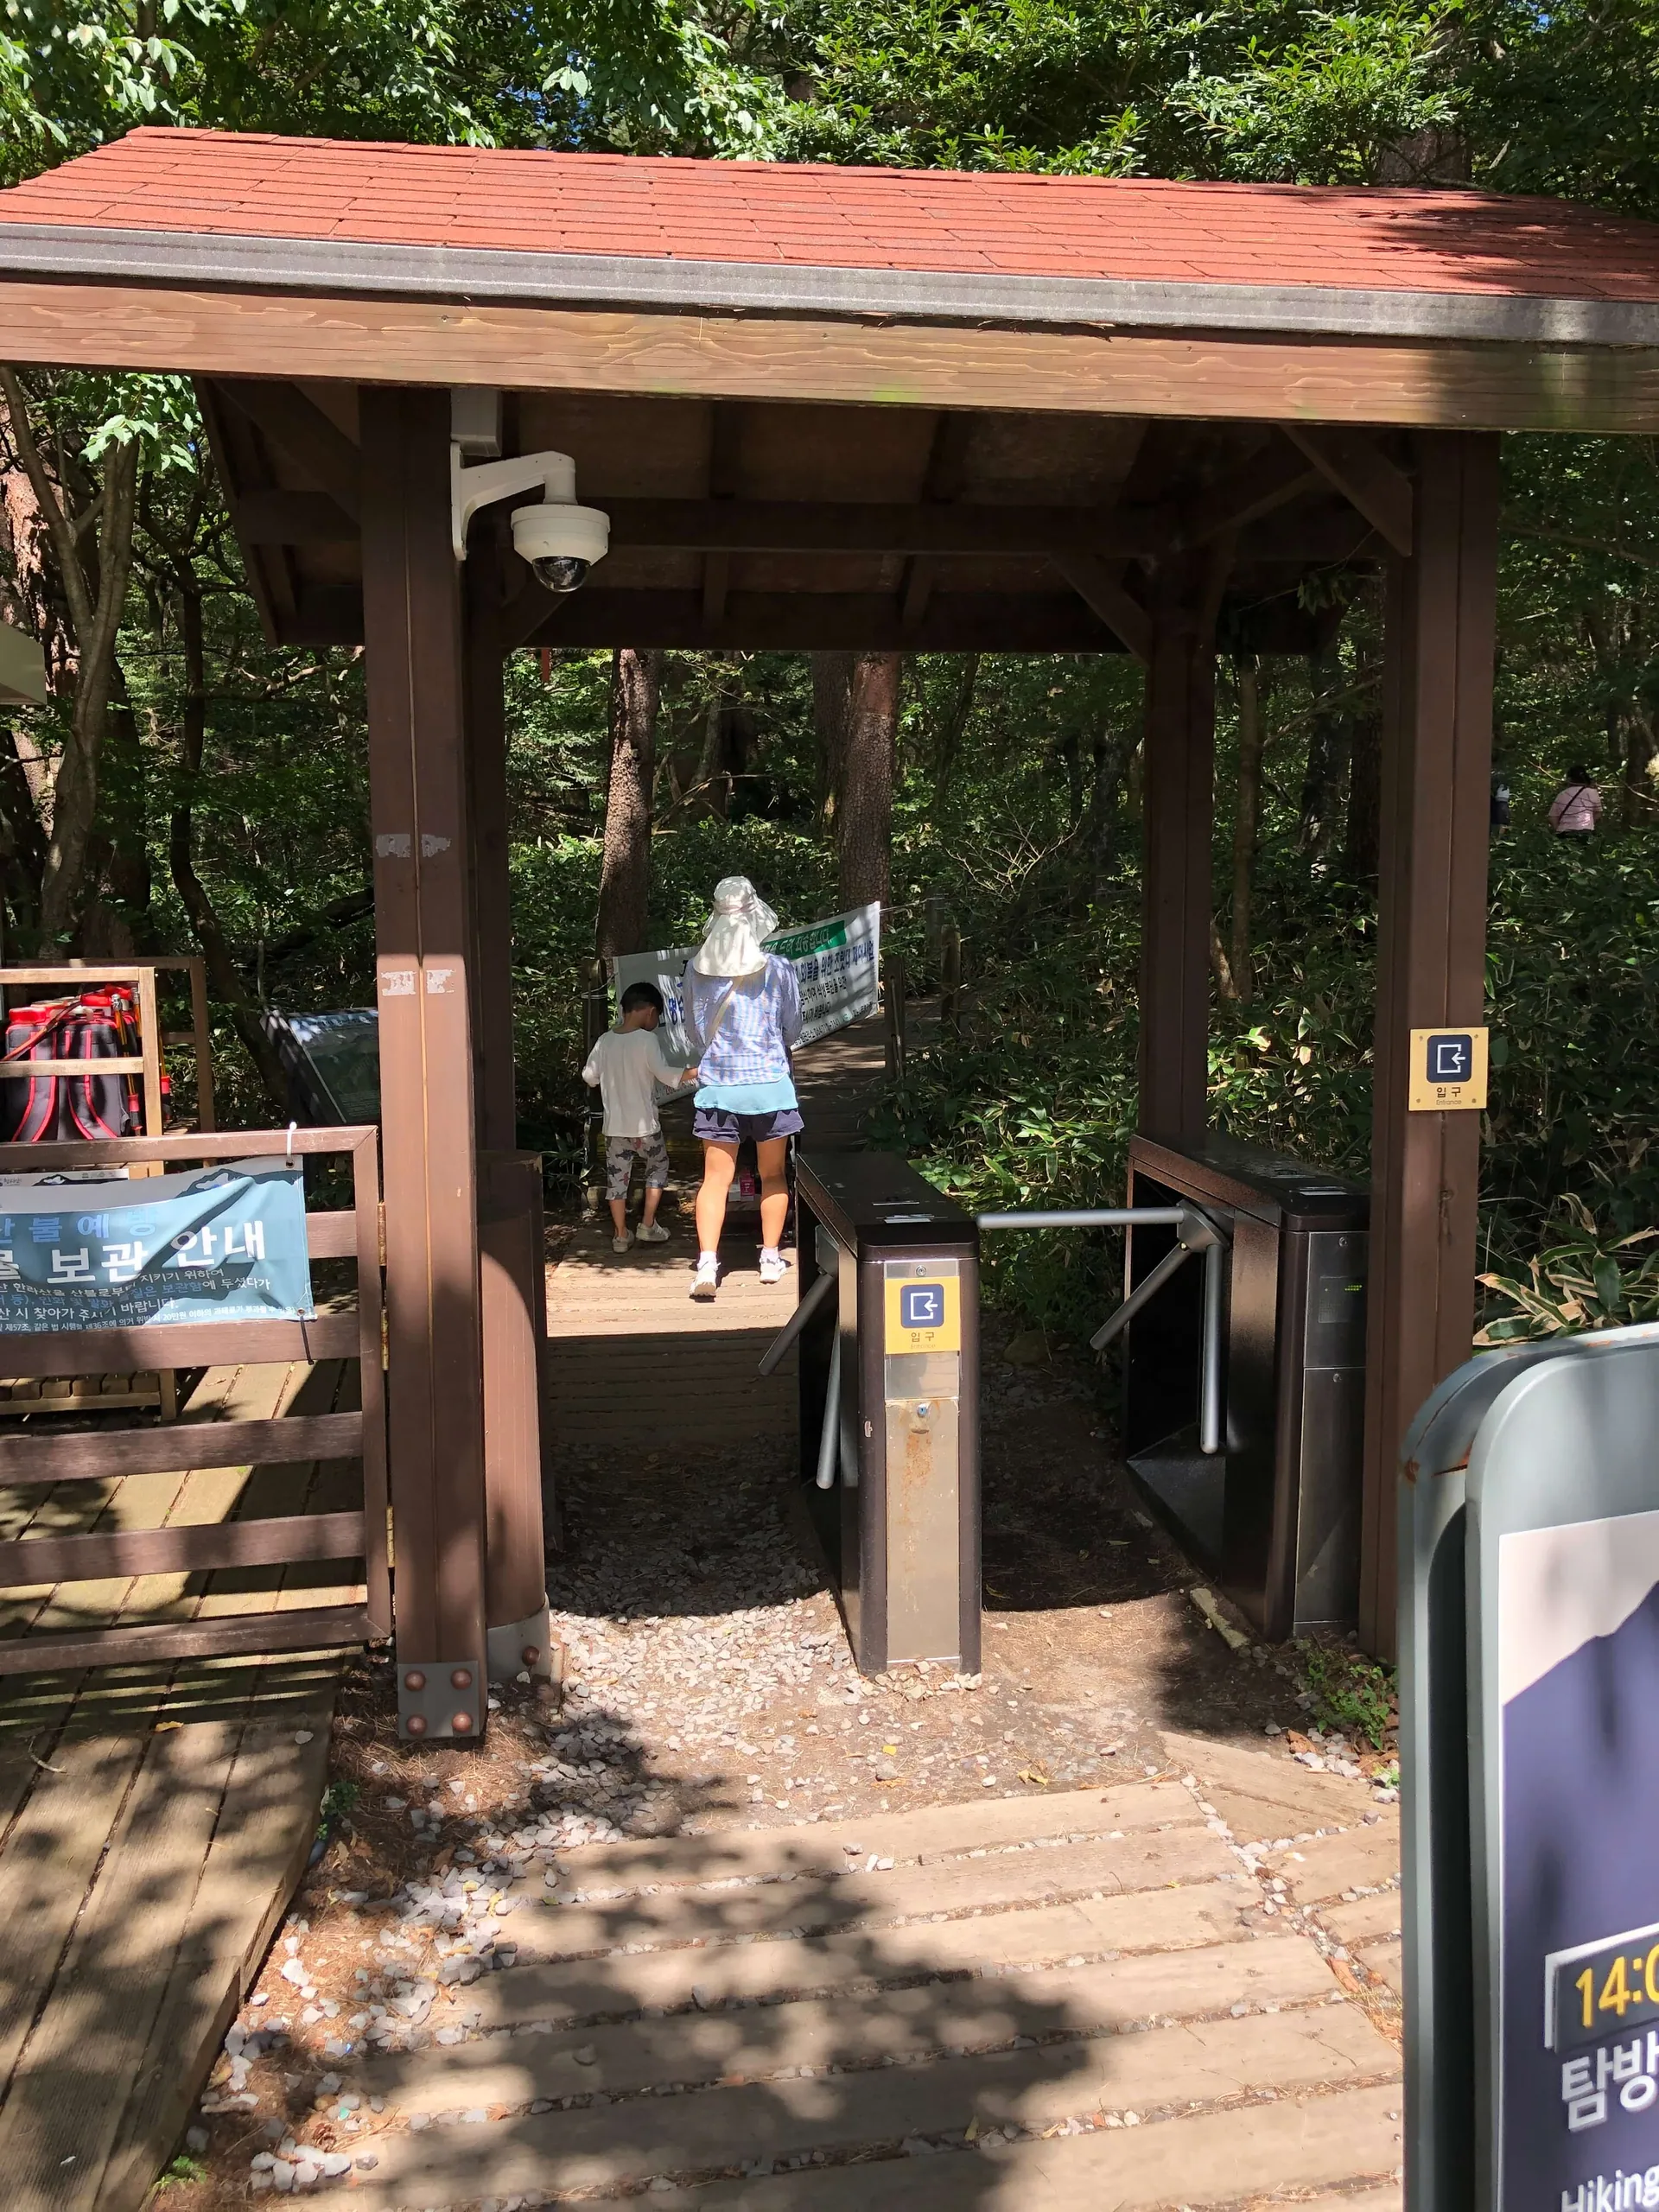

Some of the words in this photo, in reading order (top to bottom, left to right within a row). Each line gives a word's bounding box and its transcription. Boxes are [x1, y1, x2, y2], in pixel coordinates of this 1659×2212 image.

[1436, 1086, 1461, 1098] 입구
[47, 1240, 150, 1284] 보관
[170, 1221, 266, 1268] 안내
[13, 1282, 66, 1297] 한라산을
[140, 1272, 180, 1283] 지키기
[184, 1268, 225, 1280] 위하여
[162, 1280, 217, 1294] 보관함에
[16, 1307, 29, 1320] 시
[34, 1307, 75, 1320] 찾아가
[120, 1296, 179, 1314] 바랍니다.
[162, 1311, 188, 1321] 20만원
[911, 1332, 935, 1343] 입구
